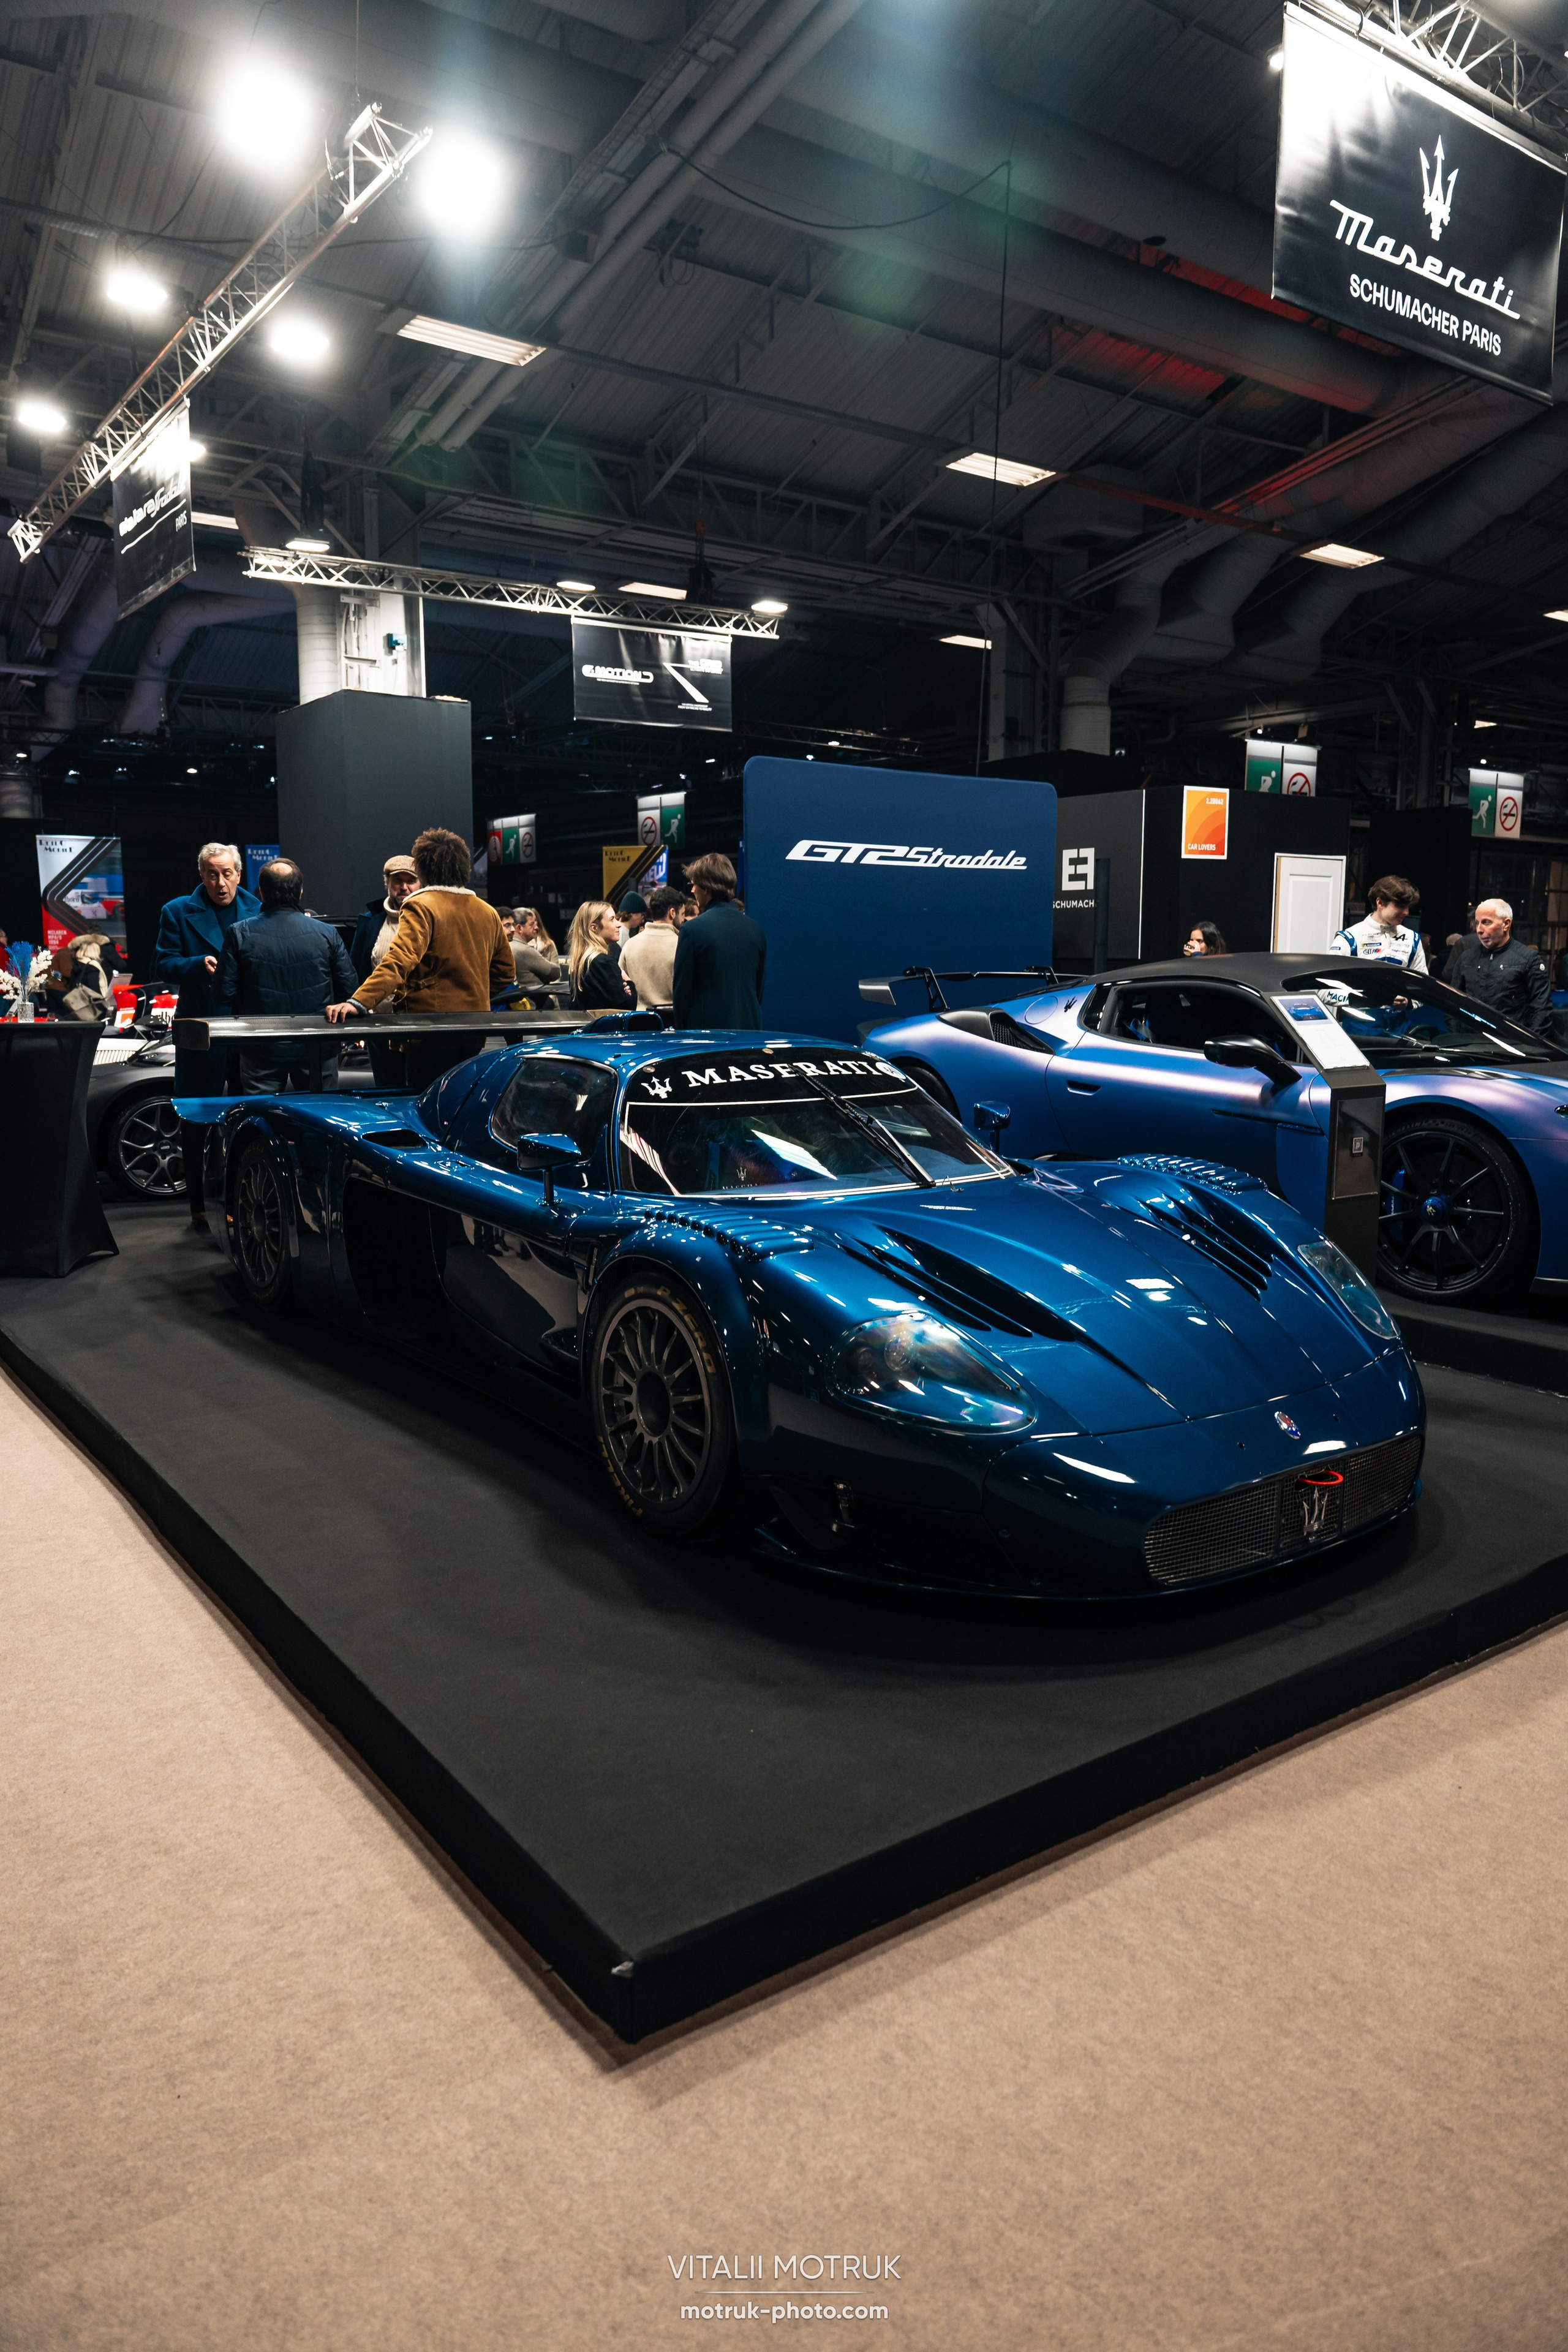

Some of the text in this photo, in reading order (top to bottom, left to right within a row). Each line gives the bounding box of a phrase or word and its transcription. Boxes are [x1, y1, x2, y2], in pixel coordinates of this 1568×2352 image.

[1330, 200, 1520, 319] Maserati
[1350, 273, 1502, 356] SCHUMACHER PARIS
[785, 839, 1028, 870] GT2 Stradale
[681, 1060, 883, 1088] MASERATI
[656, 1285, 717, 1374] P ZERO
[597, 1434, 644, 1517] PIRELLI
